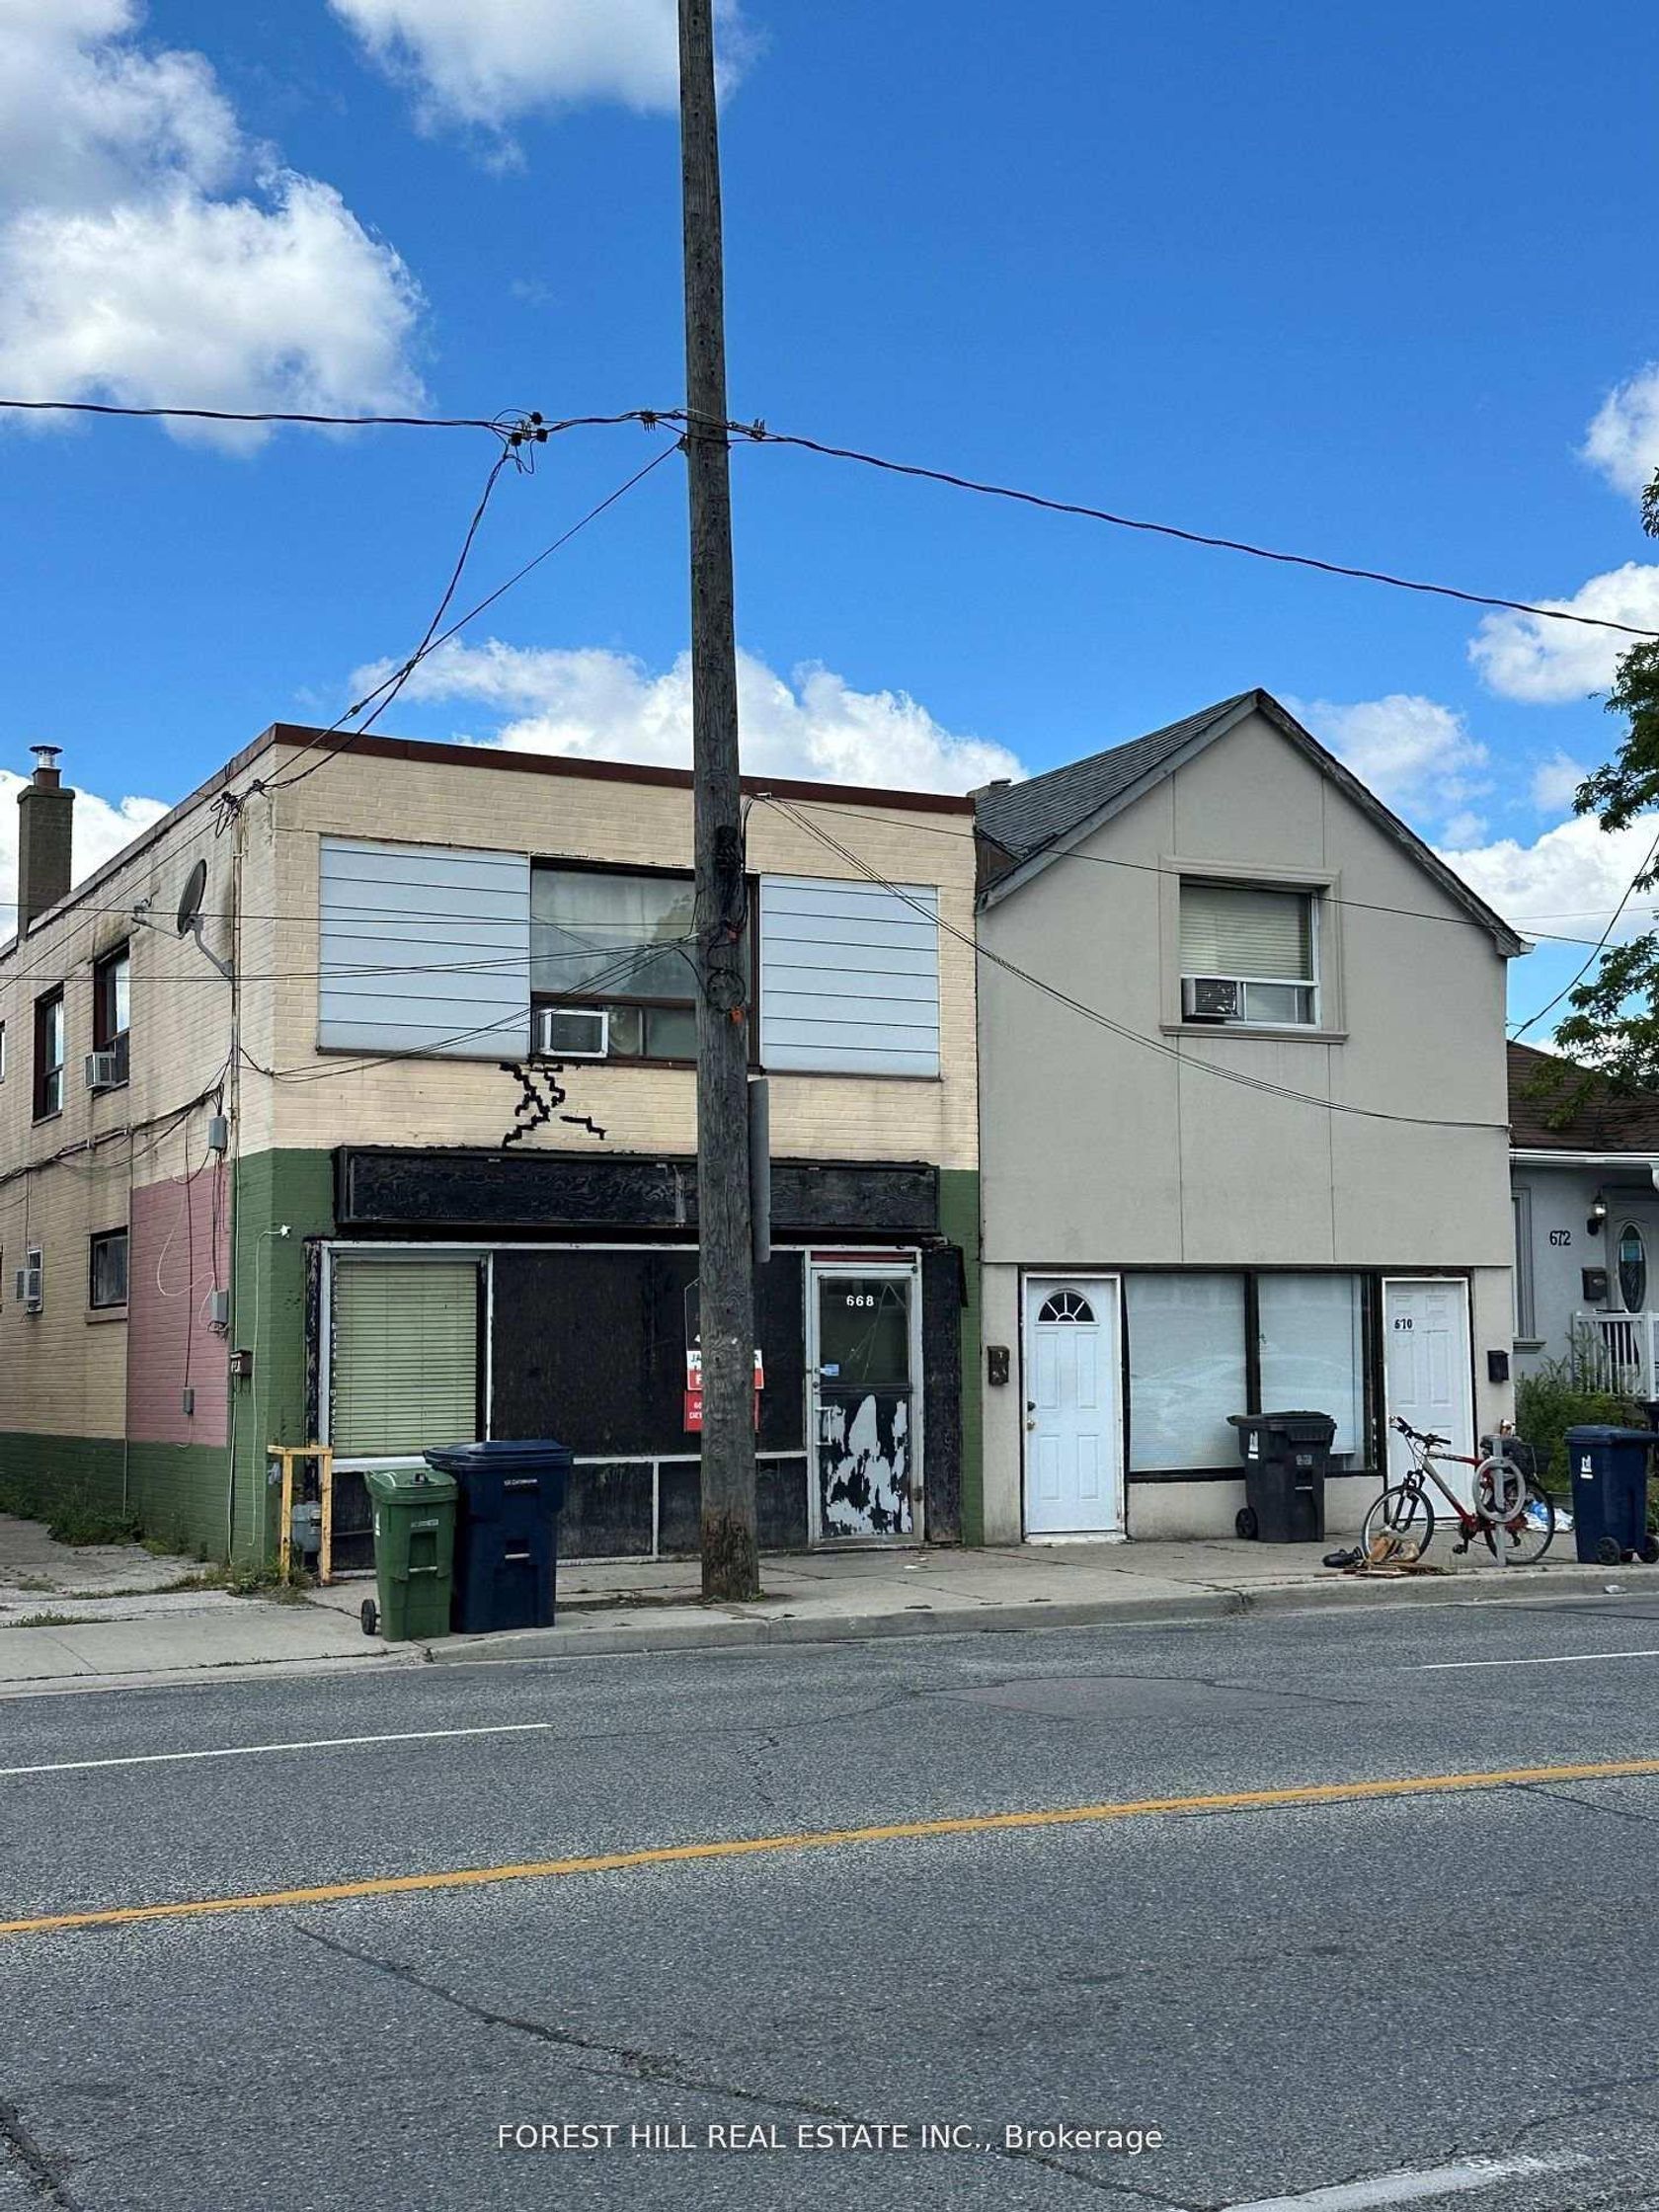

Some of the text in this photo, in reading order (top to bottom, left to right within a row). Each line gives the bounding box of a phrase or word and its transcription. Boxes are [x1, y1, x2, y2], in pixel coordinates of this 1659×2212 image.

[1549, 1230, 1571, 1246] 672
[846, 1295, 875, 1306] 668
[1394, 1318, 1413, 1330] 670
